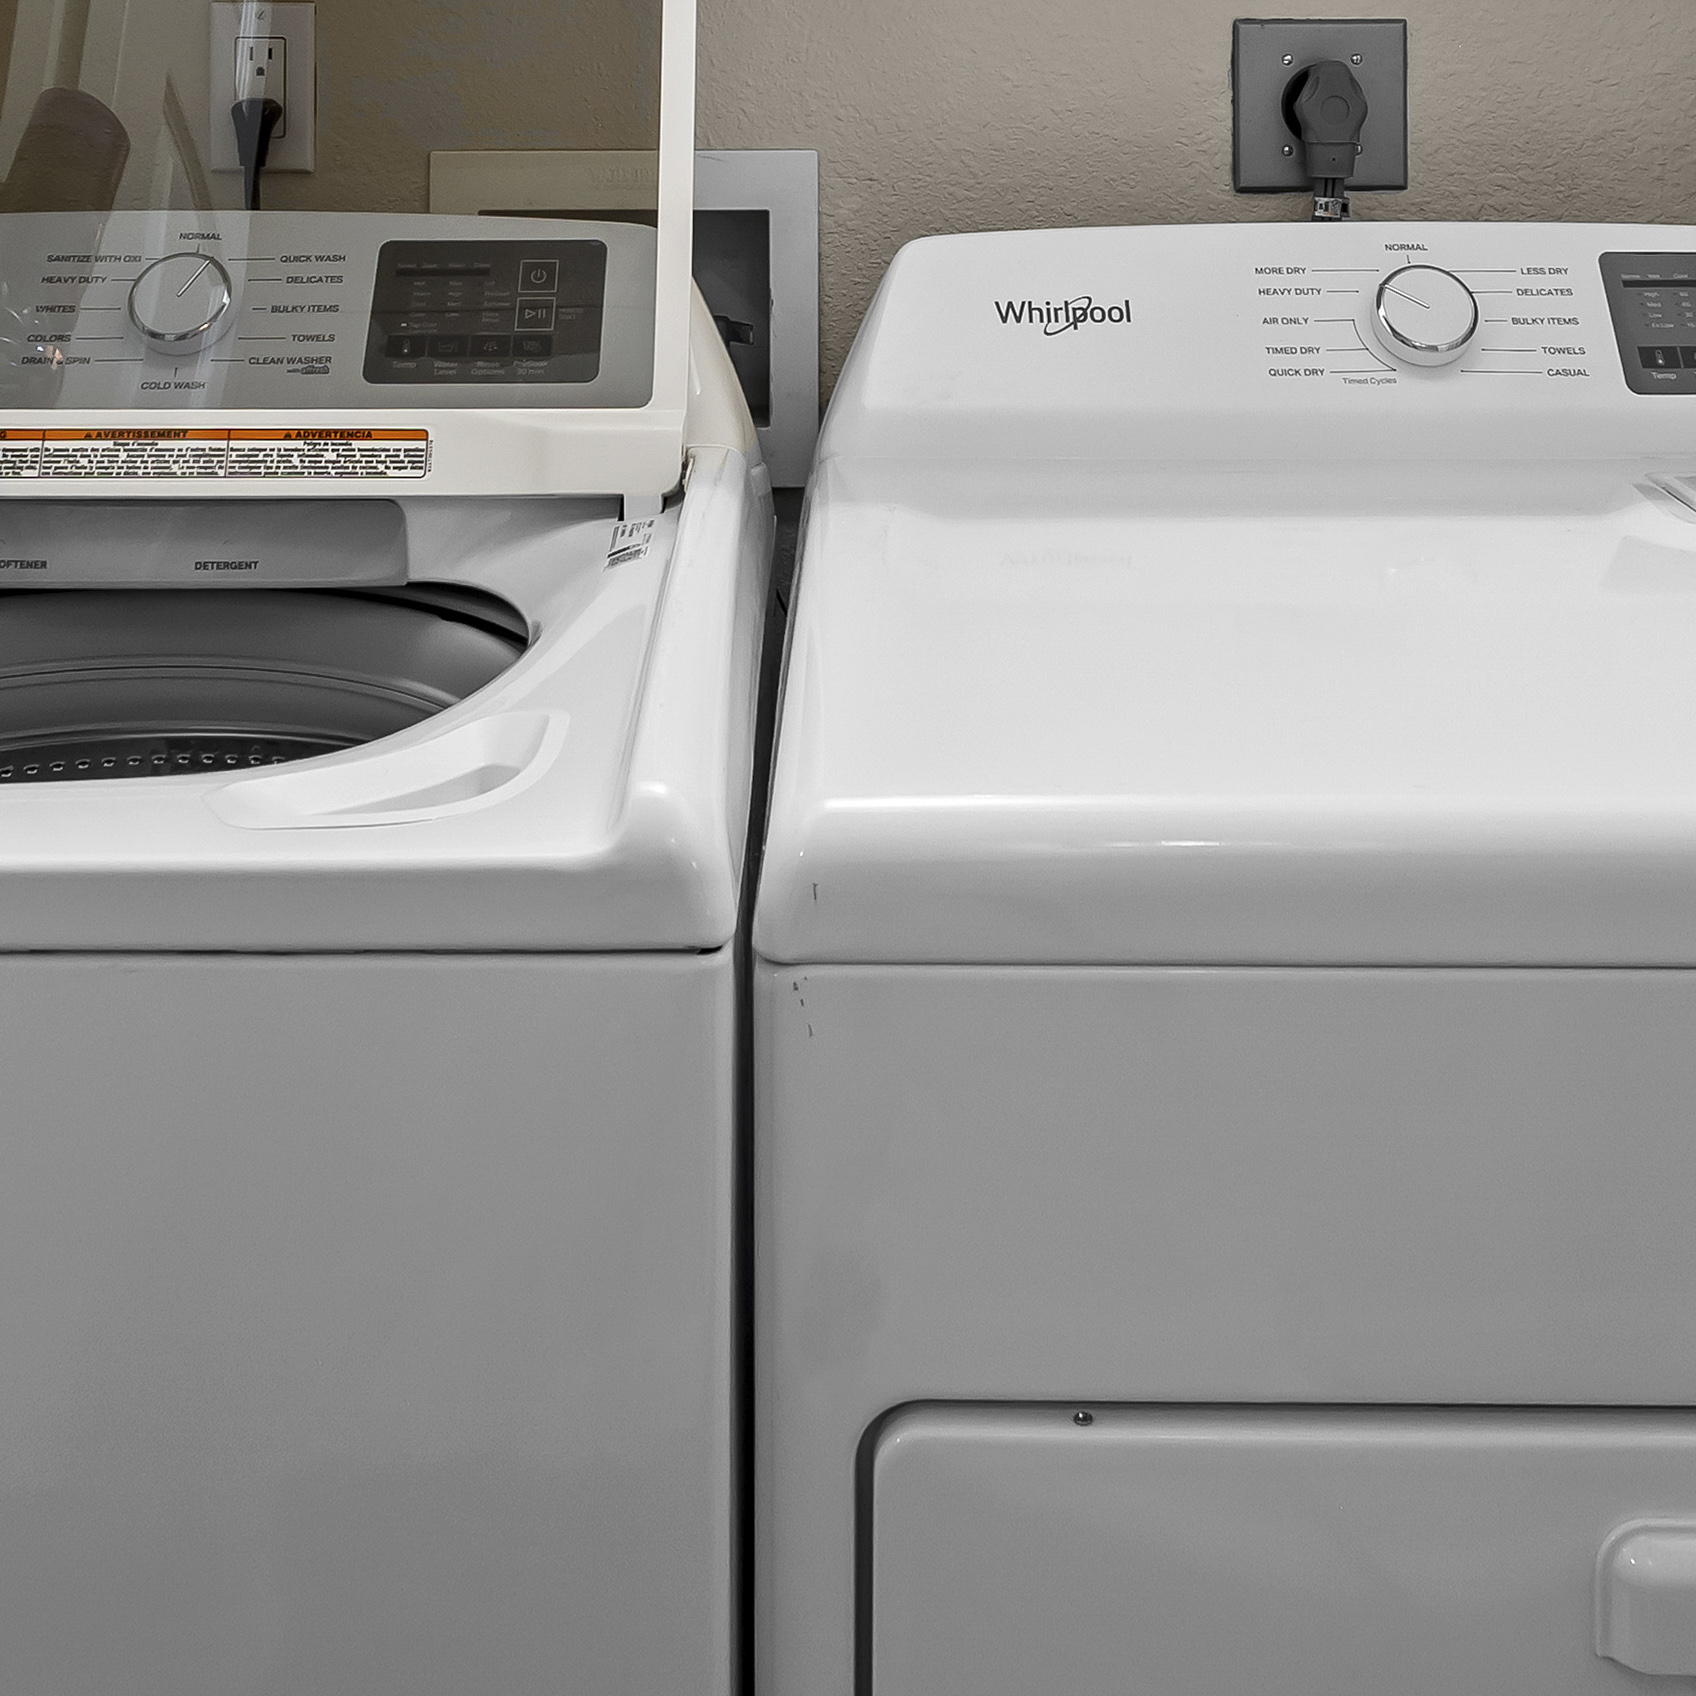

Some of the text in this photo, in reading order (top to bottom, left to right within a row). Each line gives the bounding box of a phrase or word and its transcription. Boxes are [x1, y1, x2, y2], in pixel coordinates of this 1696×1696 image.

[179, 232, 222, 240] NORMAL
[46, 255, 142, 263] SANITIZE WITH OXI
[280, 255, 312, 263] QUICK
[41, 276, 107, 284] HEAVY DUTY
[286, 275, 344, 284] DELICATES
[1517, 288, 1573, 296] DELICATES
[35, 305, 76, 313] WHITES
[270, 305, 340, 313] BULKY ITEMS
[994, 296, 1131, 336] Whirlpool
[1262, 317, 1309, 325] AIR ONLY
[1511, 317, 1579, 325] BULKY ITEMS
[27, 334, 72, 342] COLORS
[291, 334, 336, 342] TOWELS
[21, 357, 54, 365] DRAIN
[65, 357, 91, 365] SPIN
[248, 356, 332, 365] CLEAN WASHER
[1269, 369, 1301, 377] QUICK
[1651, 372, 1677, 380] Temp
[1369, 377, 1397, 385] Cycles
[141, 381, 206, 390] COLD WASH
[194, 561, 259, 570] DETERGENT
